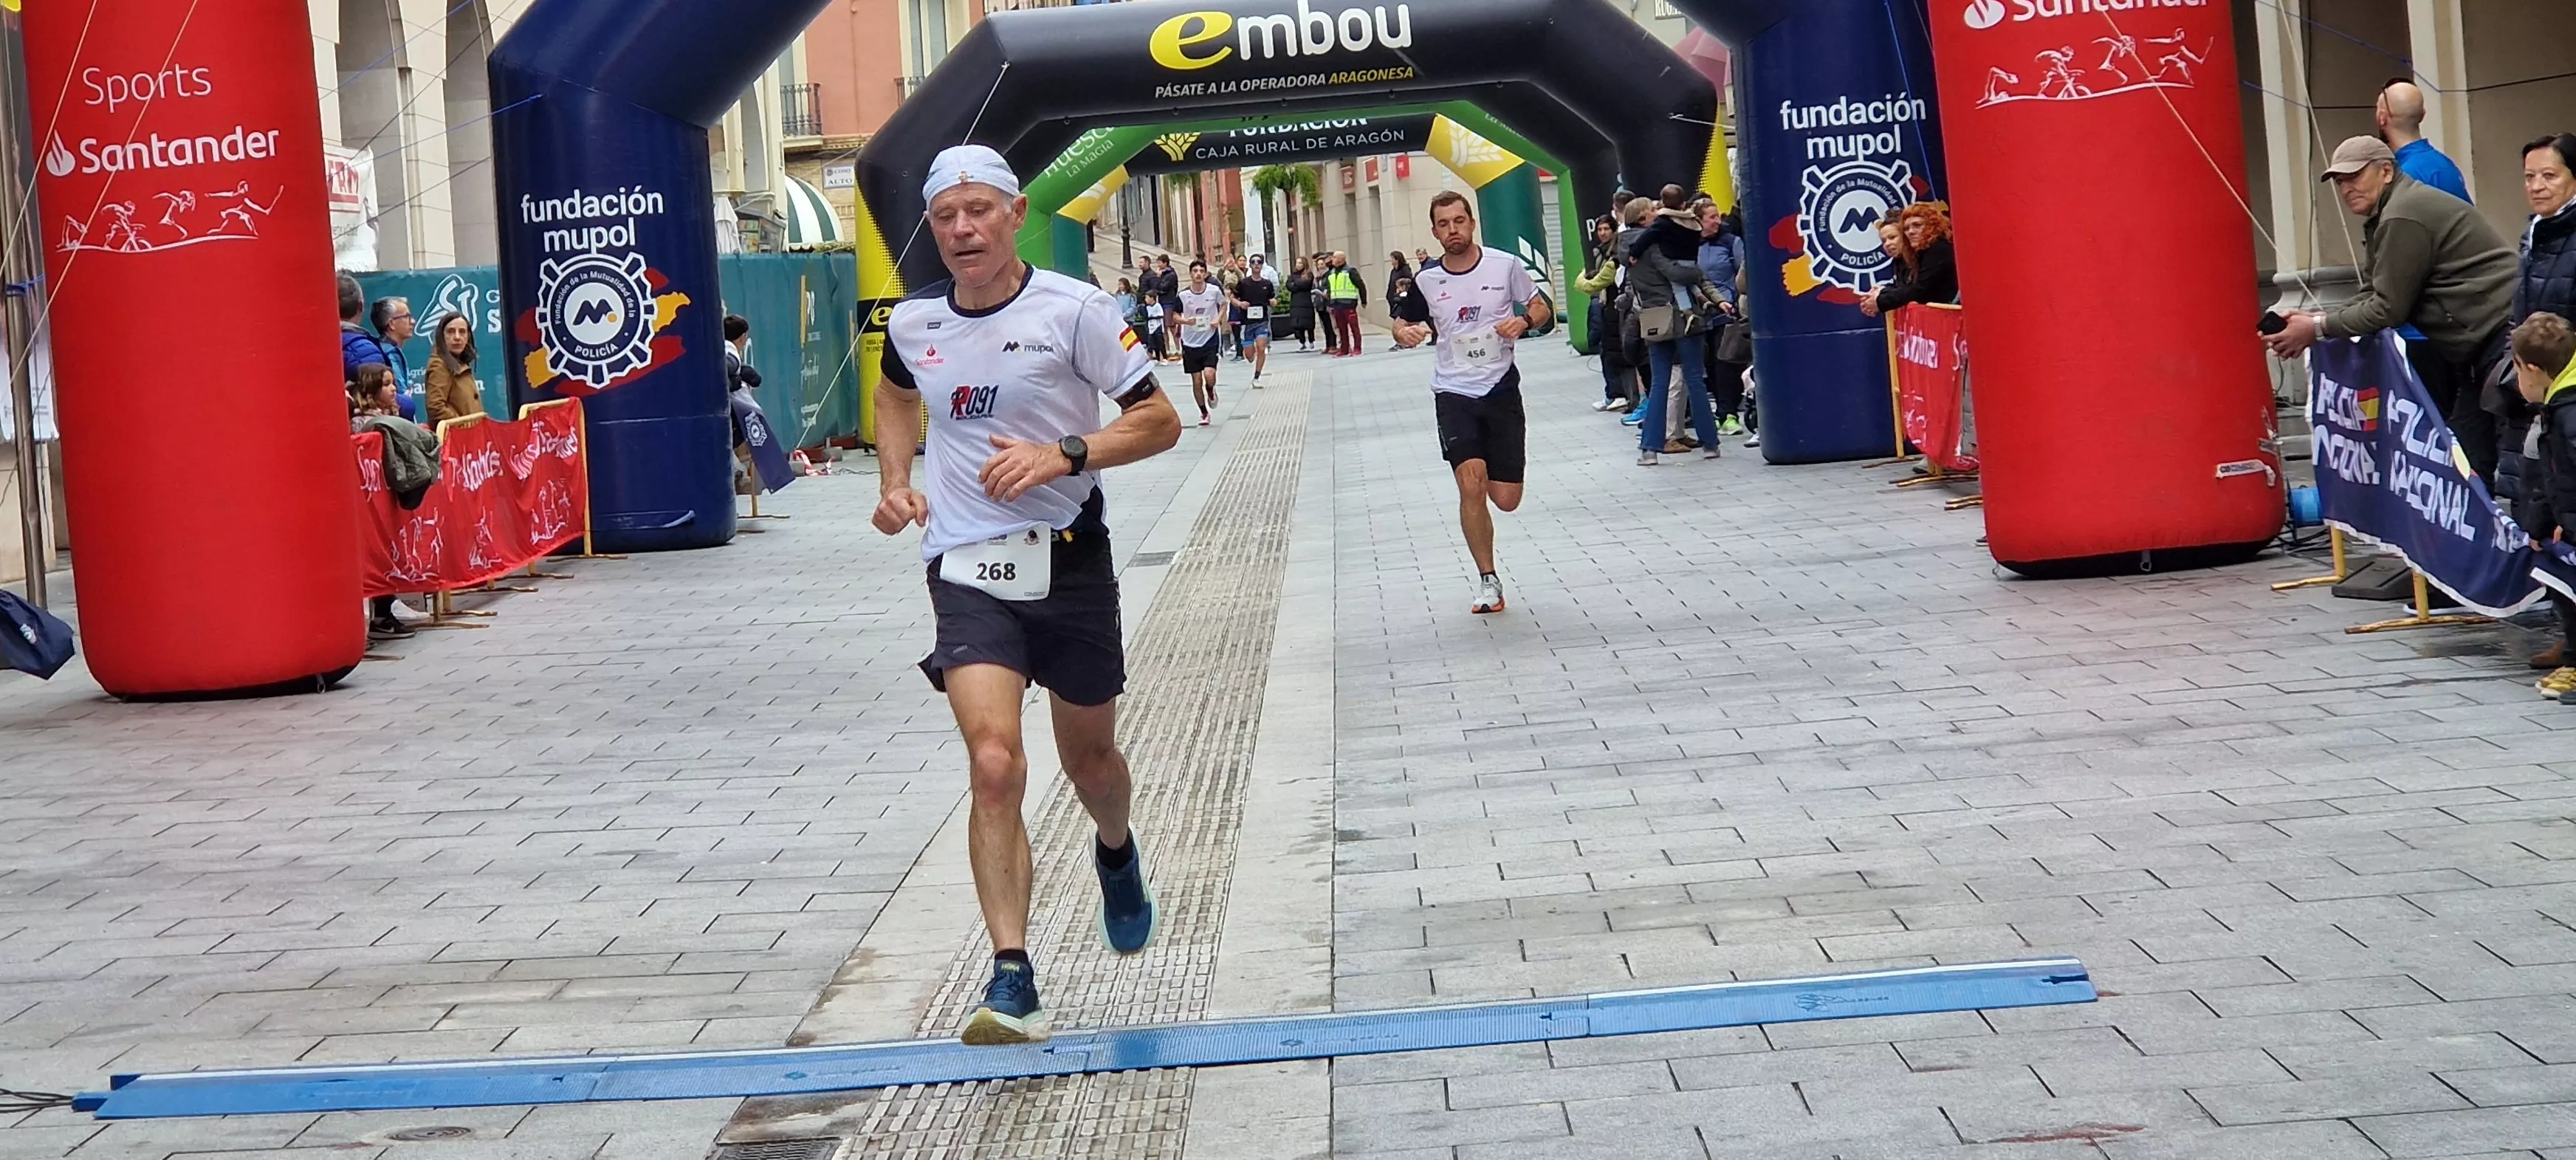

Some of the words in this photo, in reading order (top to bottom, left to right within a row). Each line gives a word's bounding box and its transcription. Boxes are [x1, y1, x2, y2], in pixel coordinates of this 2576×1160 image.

[1150, 0, 1412, 70] embou
[82, 64, 212, 113] Sports
[1155, 83, 1205, 98] PÁSATE
[1206, 82, 1217, 95] A
[1220, 80, 1237, 93] LA
[1240, 73, 1326, 92] OPERADORA
[1328, 66, 1414, 85] ARAGONESA
[1779, 92, 1926, 130] fundación
[80, 125, 280, 174] Santander
[1195, 148, 1239, 159] CAJA
[1245, 140, 1300, 155] RURAL
[1306, 137, 1328, 149] DE
[1333, 128, 1404, 147] ARAGÓN
[1807, 124, 1902, 162] mupol
[521, 185, 664, 223] fundación
[543, 217, 636, 255] mupol
[1841, 250, 1886, 267] POLICÍA
[574, 343, 619, 357] POLICÍA
[1024, 343, 1054, 354] mupol
[1467, 348, 1486, 359] 456
[975, 562, 1017, 581] 268
